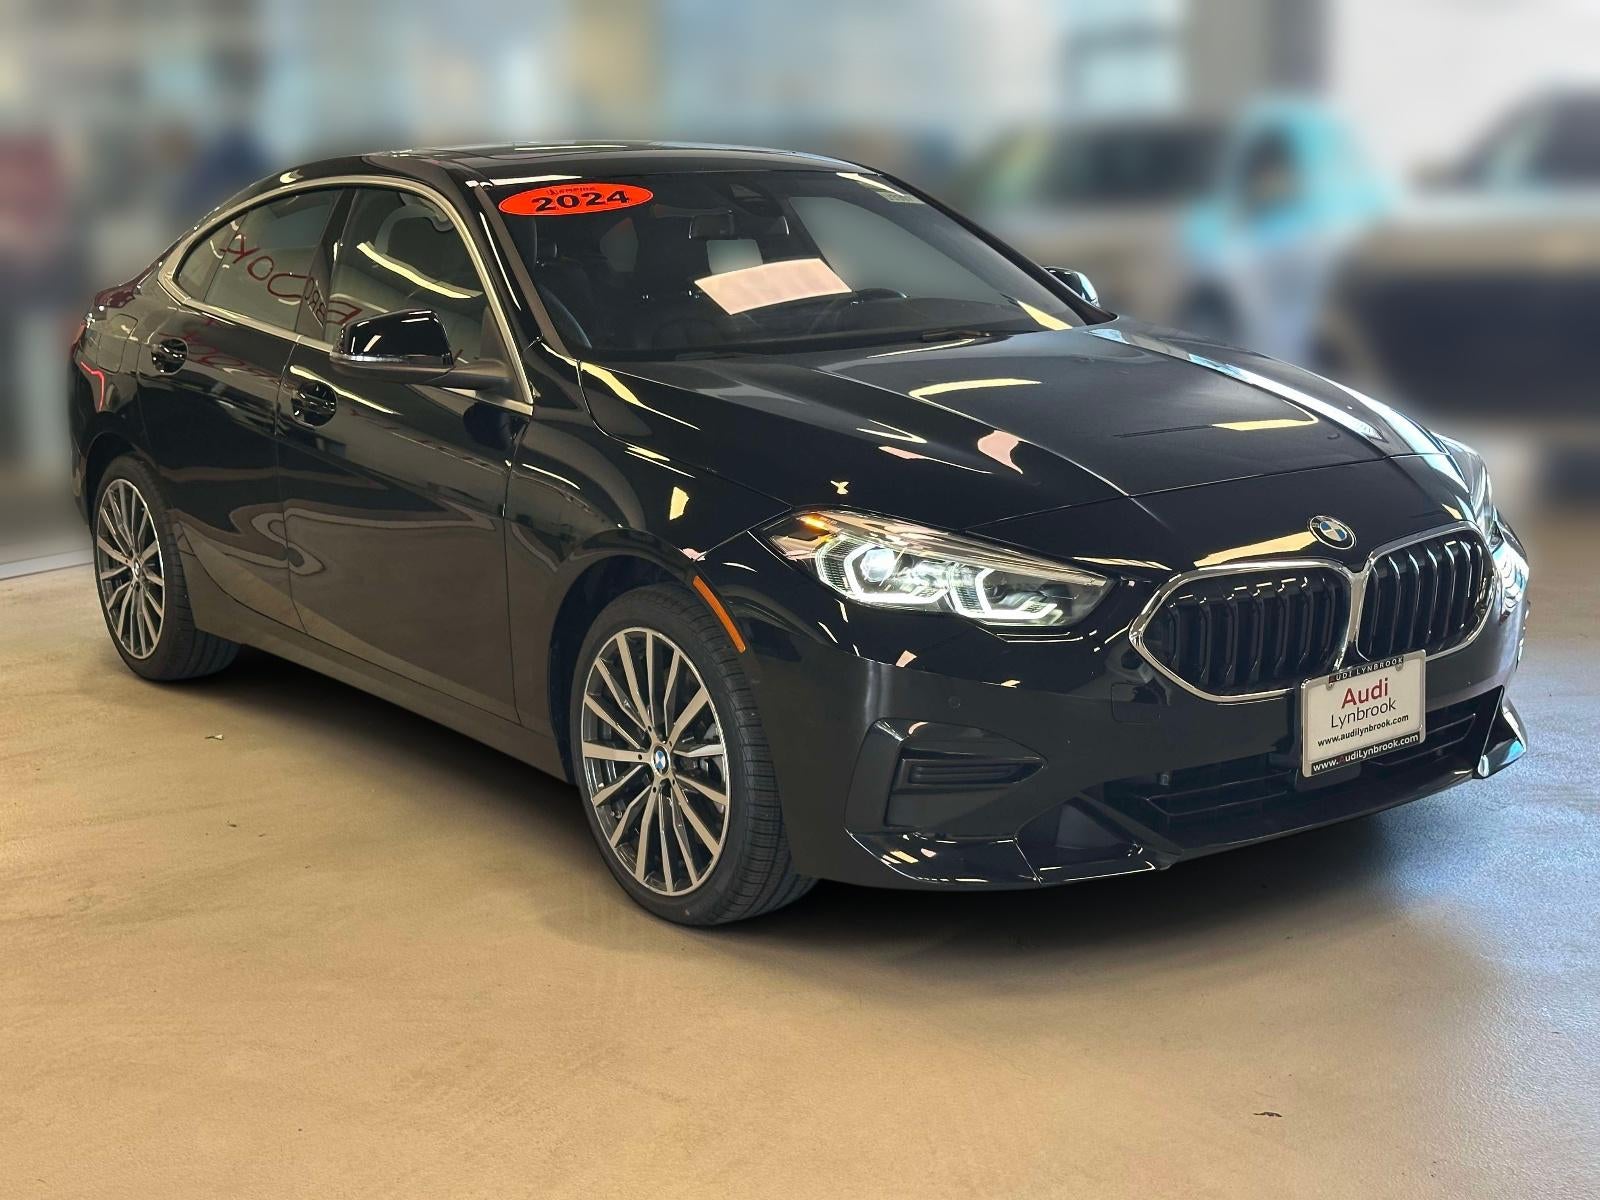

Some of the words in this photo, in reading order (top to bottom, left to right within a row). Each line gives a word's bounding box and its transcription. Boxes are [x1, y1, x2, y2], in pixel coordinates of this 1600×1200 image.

[531, 190, 630, 212] 2024
[1329, 671, 1352, 683] UDI
[1356, 657, 1404, 675] LYNBROOK
[1341, 678, 1388, 709] Audi
[1331, 697, 1396, 729] Lynbrook
[1317, 714, 1409, 747] www.audilynbrook.com
